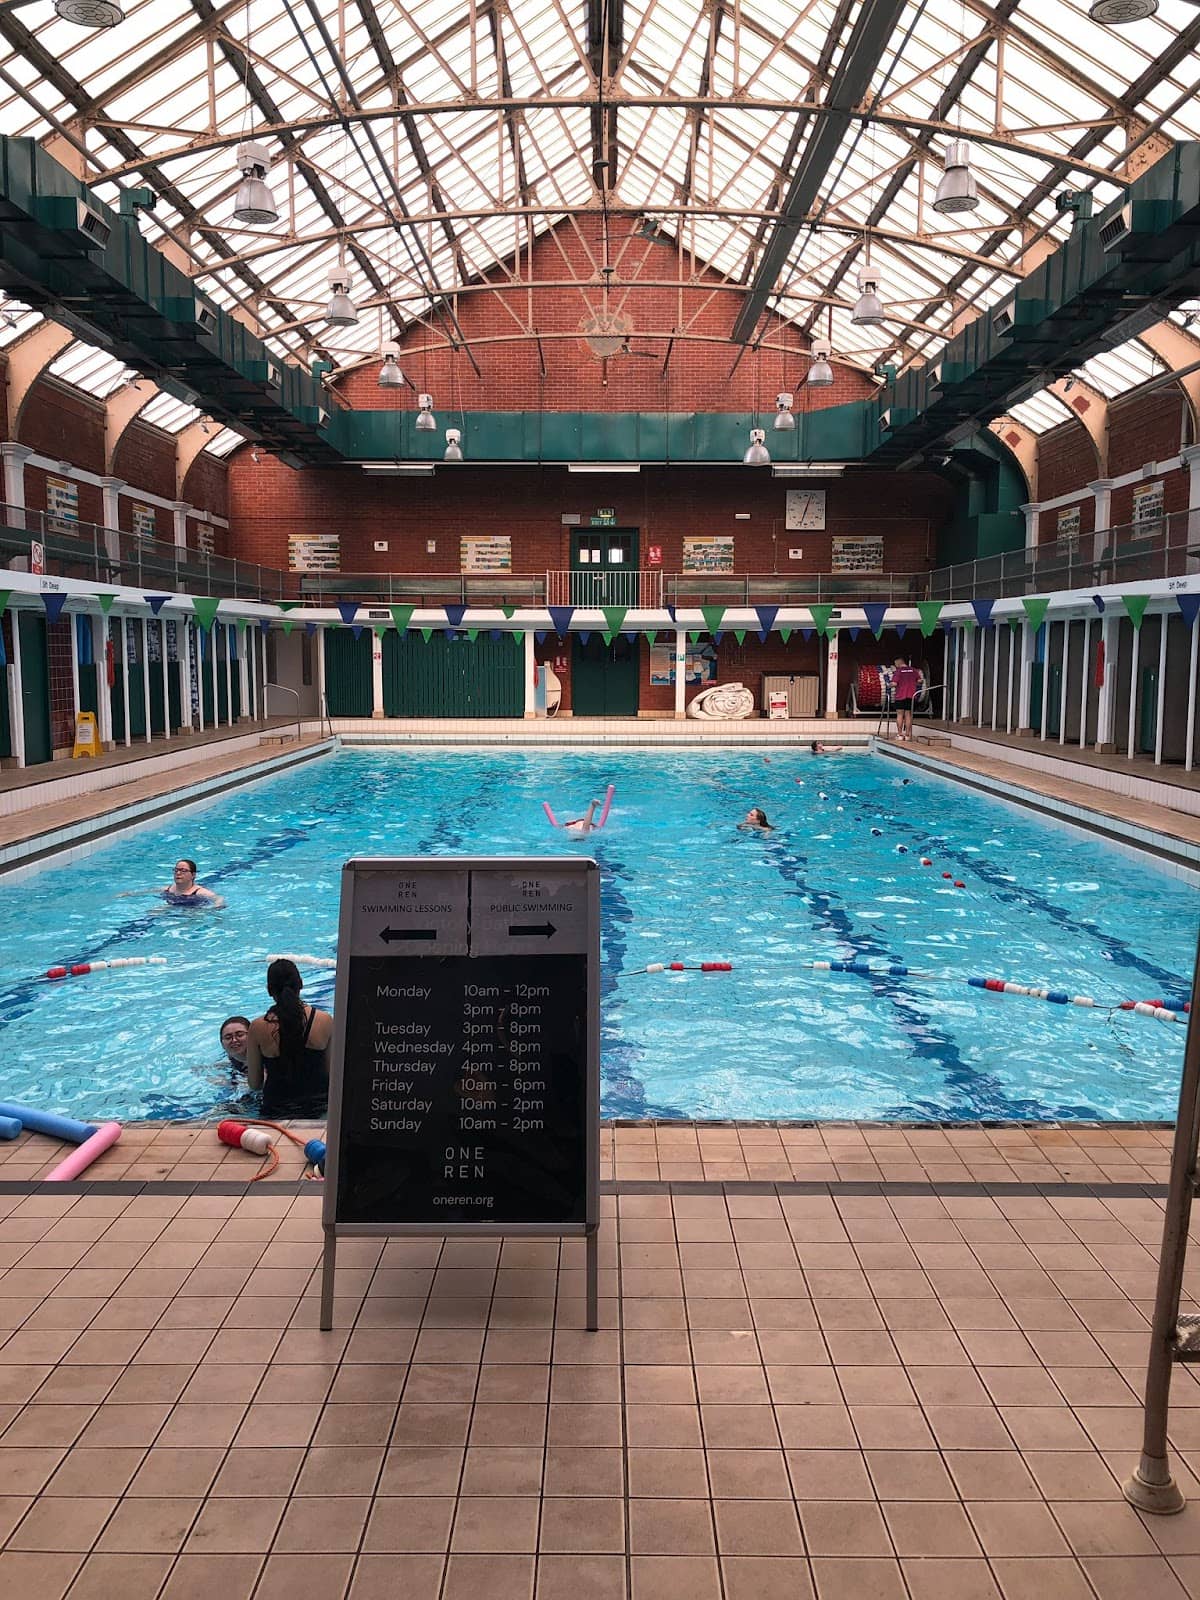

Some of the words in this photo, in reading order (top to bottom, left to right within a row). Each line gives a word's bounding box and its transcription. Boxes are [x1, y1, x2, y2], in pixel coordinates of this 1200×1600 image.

[398, 881, 417, 889] ONE
[398, 891, 417, 899] REN
[362, 904, 412, 912] SWIMMING
[415, 904, 452, 912] LESSONS
[490, 904, 520, 912] PUBLIC
[523, 904, 573, 912] SWIMMING
[376, 985, 432, 1000] Monday
[464, 985, 499, 996] 10am
[516, 984, 550, 999] 12pm
[463, 1003, 494, 1018] 3pm
[510, 1002, 541, 1017] 8pm
[376, 1022, 432, 1037] Tuesday
[462, 1021, 494, 1036] 3pm
[510, 1021, 541, 1036] 8pm
[374, 1040, 455, 1056] Wednesday
[462, 1040, 494, 1055] 4pm
[510, 1040, 541, 1055] 8pm
[373, 1060, 436, 1075] Thursday
[461, 1060, 493, 1074] 4pm
[510, 1058, 541, 1074] 8pm
[372, 1079, 414, 1094] Friday
[461, 1078, 497, 1090] 10am
[513, 1078, 545, 1093] 6pm
[371, 1098, 432, 1113] Saturday
[461, 1098, 497, 1110] 10am
[513, 1097, 544, 1112] 2pm
[370, 1116, 422, 1132] Sunday
[460, 1116, 496, 1129] 10am
[512, 1116, 544, 1132] 2pm
[445, 1146, 485, 1160] ONE
[444, 1165, 484, 1178] REN
[432, 1196, 494, 1208] oneren.org
